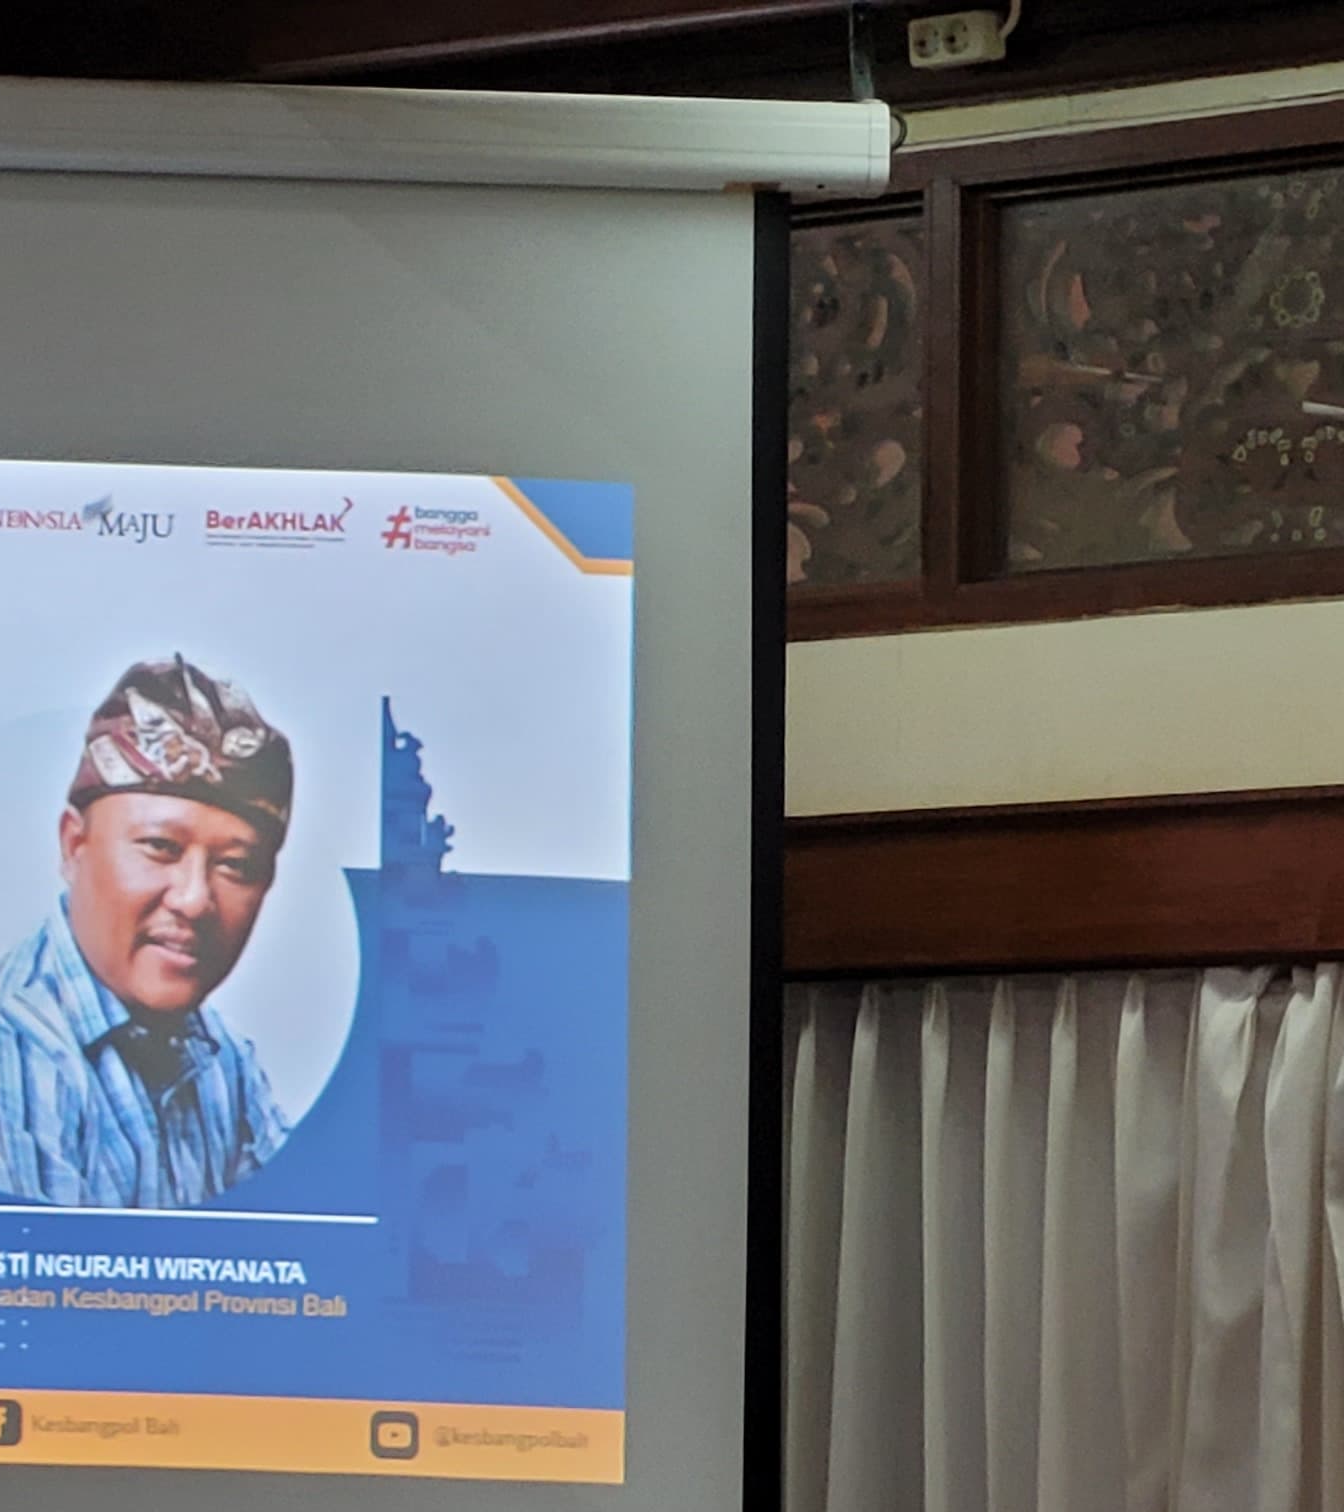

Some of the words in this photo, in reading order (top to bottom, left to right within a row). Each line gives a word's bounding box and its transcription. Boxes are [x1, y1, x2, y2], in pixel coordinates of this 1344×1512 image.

[96, 511, 176, 544] MAJU
[205, 509, 346, 533] BerAKHLAK
[413, 506, 480, 523] bangga
[35, 1254, 150, 1280] NGURAH
[154, 1257, 308, 1286] WIRYANATA
[61, 1288, 198, 1316] Kesbangpol
[204, 1291, 297, 1316] Provinsi
[302, 1293, 348, 1317] Bali
